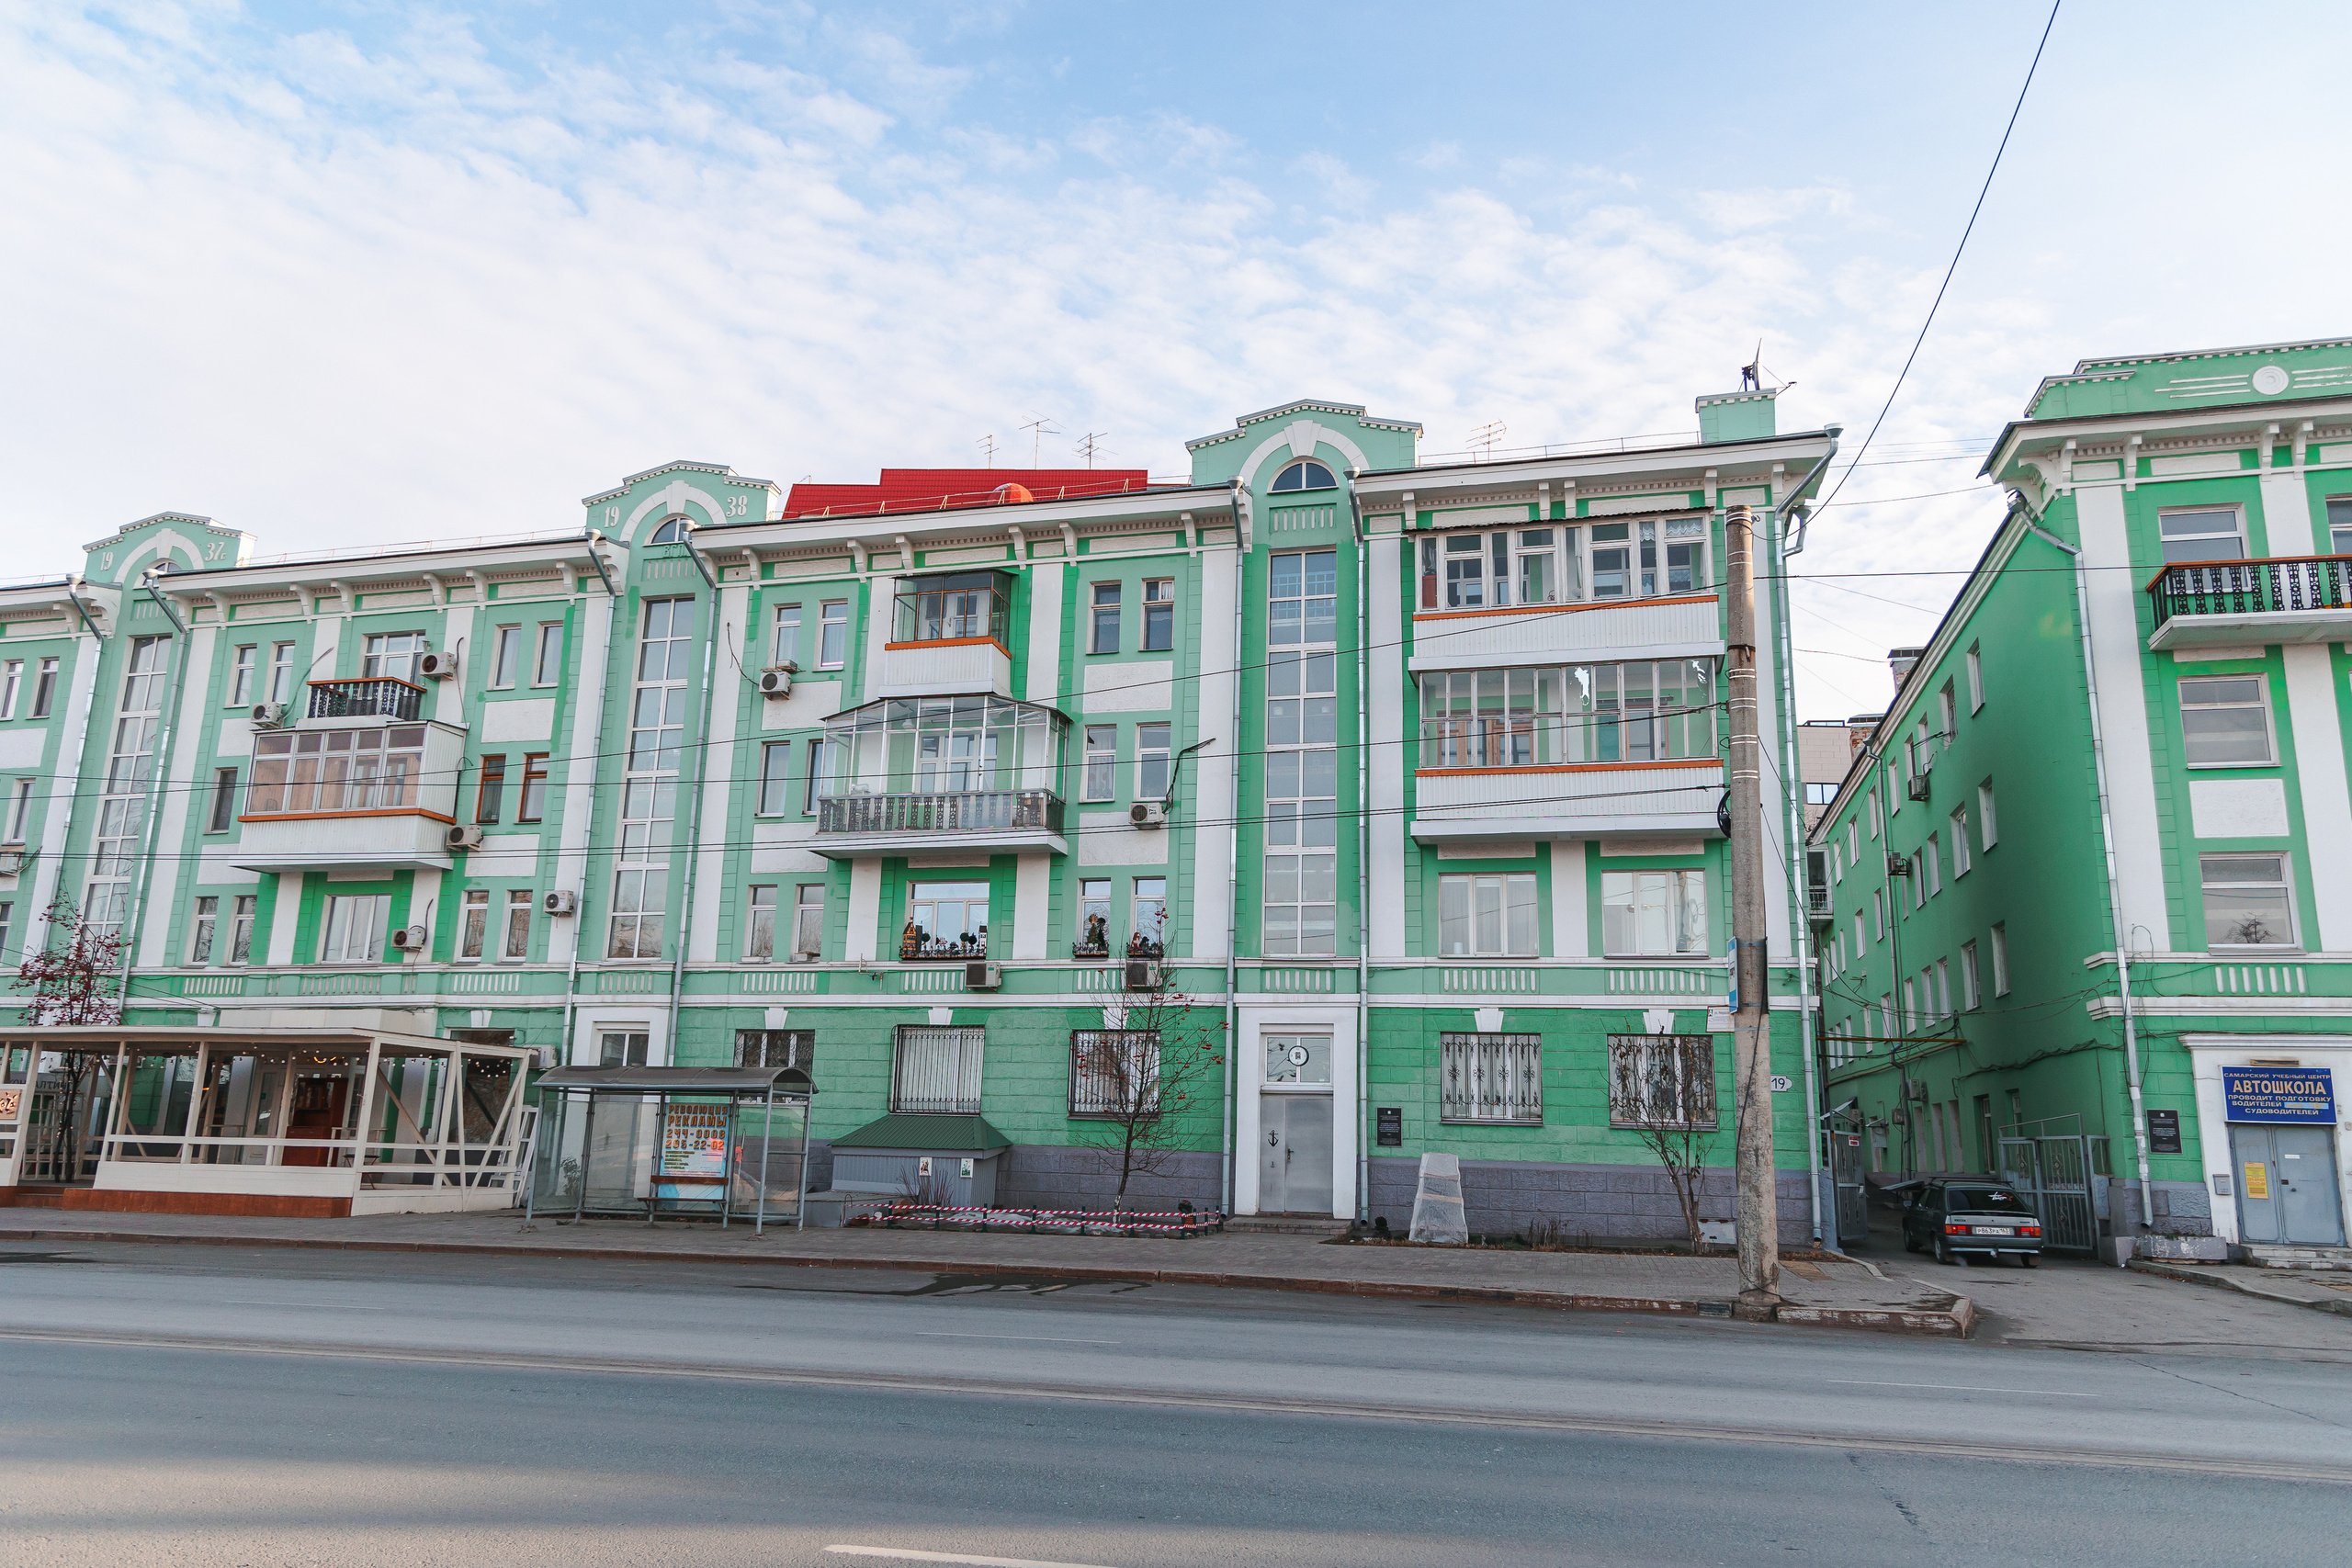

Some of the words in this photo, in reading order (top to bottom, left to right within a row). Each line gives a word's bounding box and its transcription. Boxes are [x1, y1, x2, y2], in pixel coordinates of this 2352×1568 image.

[604, 505, 620, 528] 19
[725, 495, 748, 517] 38
[100, 551, 114, 571] 19
[1770, 1077, 1786, 1089] 19
[2233, 1079, 2327, 1095] АВТОШКОЛА
[669, 1104, 728, 1115] РЕВОЛЮЦИЯ
[668, 1114, 727, 1127] РЕКЛАМЫ
[666, 1128, 726, 1139] 244-0008
[665, 1139, 725, 1151] 205-22-02
